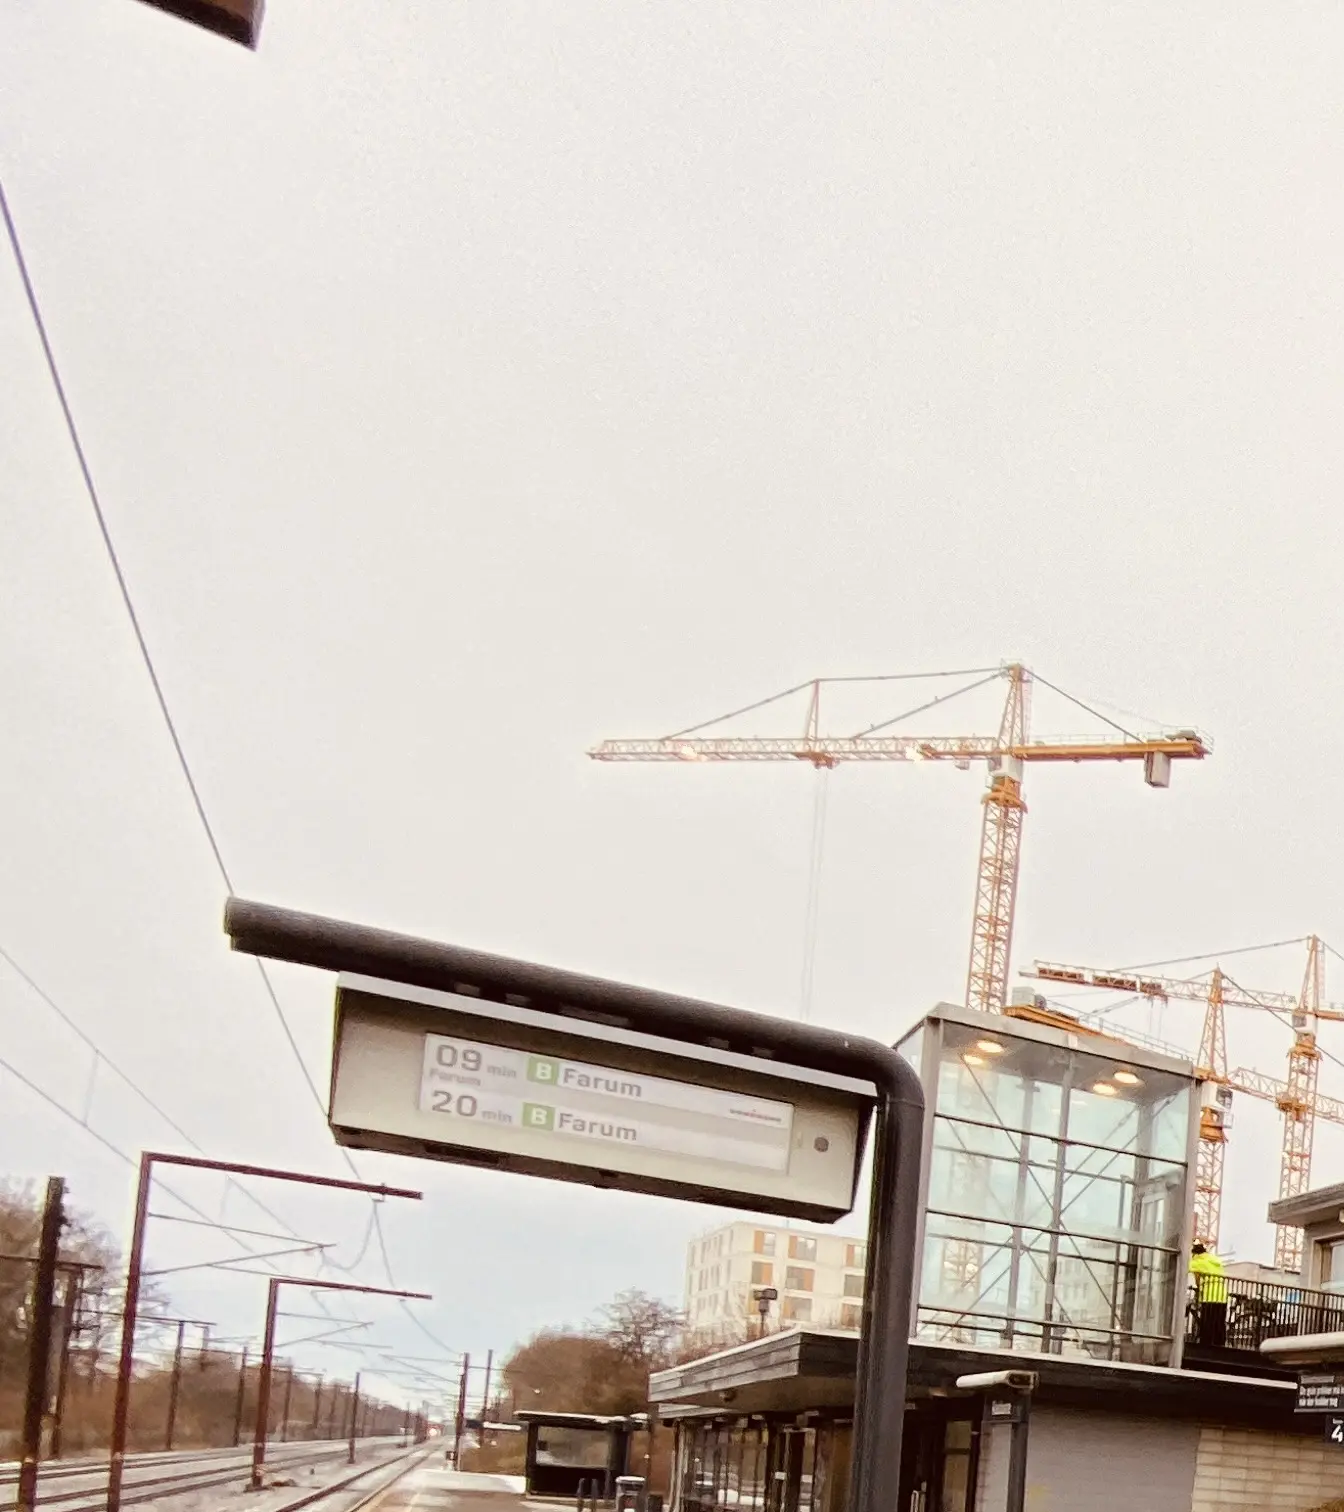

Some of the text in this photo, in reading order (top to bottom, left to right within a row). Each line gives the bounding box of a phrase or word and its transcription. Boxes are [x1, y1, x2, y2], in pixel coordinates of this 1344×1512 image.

[436, 1044, 482, 1071] 09
[486, 1064, 517, 1078] min
[562, 1067, 643, 1098] Farum
[431, 1090, 478, 1117] 20
[481, 1109, 513, 1123] min
[558, 1112, 638, 1141] Farum
[1331, 1424, 1344, 1443] 4
